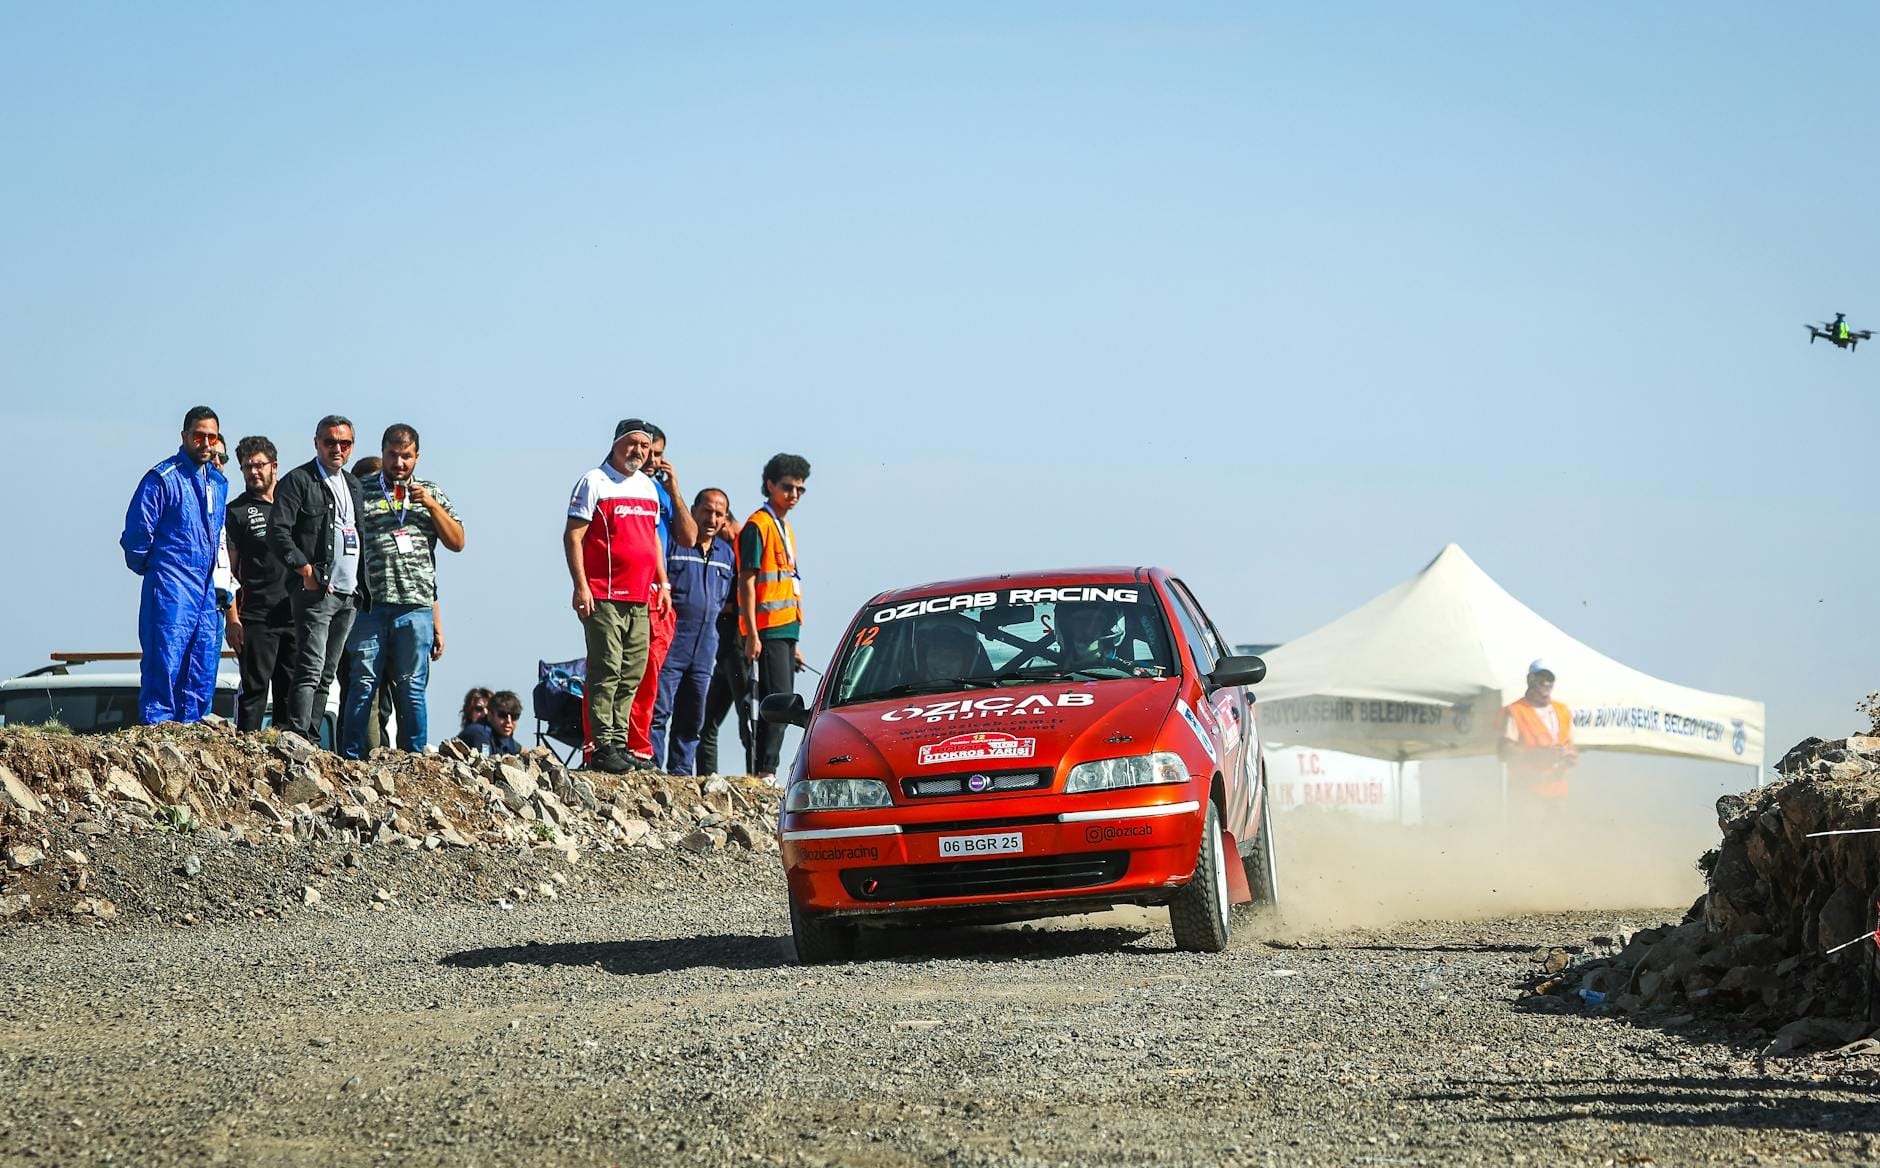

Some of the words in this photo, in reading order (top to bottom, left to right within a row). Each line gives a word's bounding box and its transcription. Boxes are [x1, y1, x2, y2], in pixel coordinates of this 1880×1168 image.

[873, 591, 998, 624] OZICAB
[1009, 587, 1139, 604] RACING
[855, 626, 880, 647] 12
[881, 693, 1095, 721] OZICAB
[1360, 701, 1442, 725] BELEDİYESİ
[924, 749, 985, 761] OTOKROS
[1297, 753, 1325, 776] T.C.
[1103, 824, 1153, 842] @ozicab
[943, 840, 961, 853] 06
[964, 838, 998, 852] BGR
[1002, 836, 1019, 850] 25
